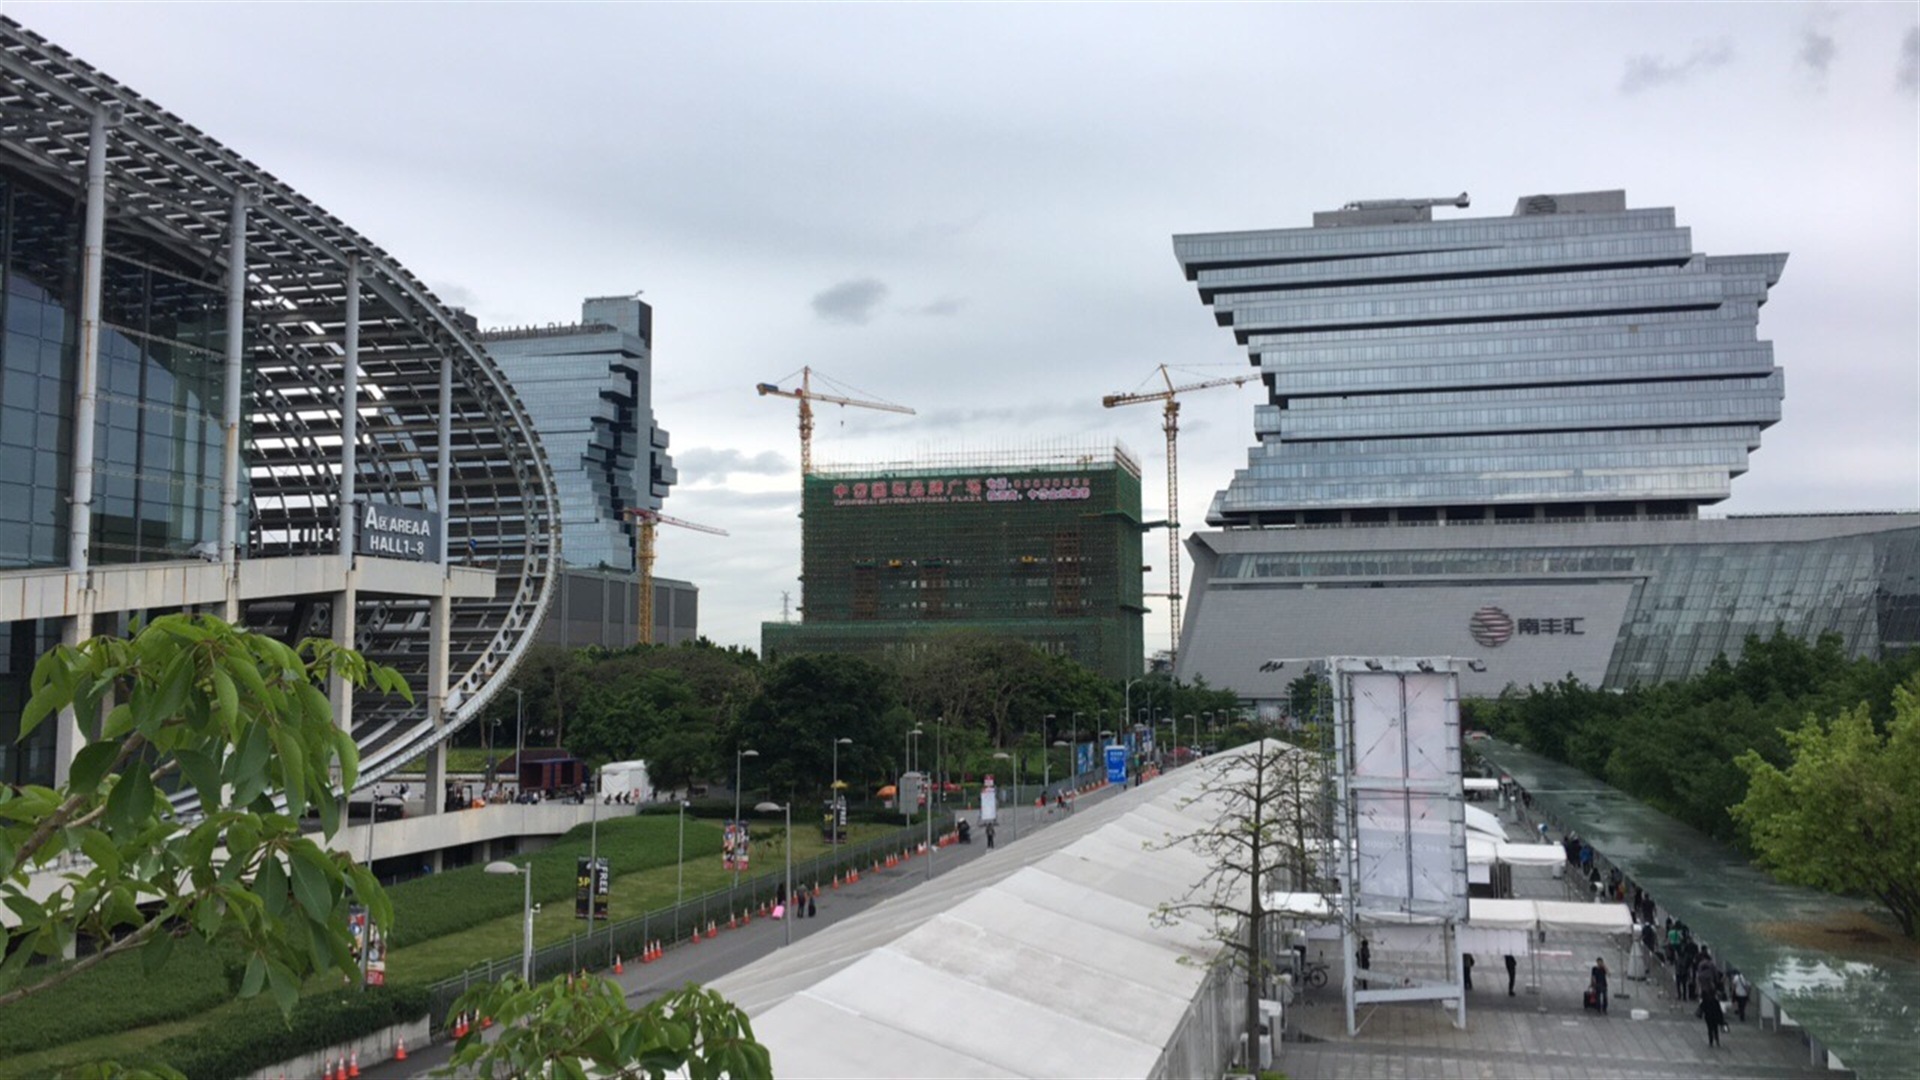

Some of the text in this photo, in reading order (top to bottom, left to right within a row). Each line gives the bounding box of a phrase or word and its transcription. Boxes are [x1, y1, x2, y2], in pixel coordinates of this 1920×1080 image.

[1518, 617, 1585, 635] 南丰汇
[600, 867, 608, 894] FREE
